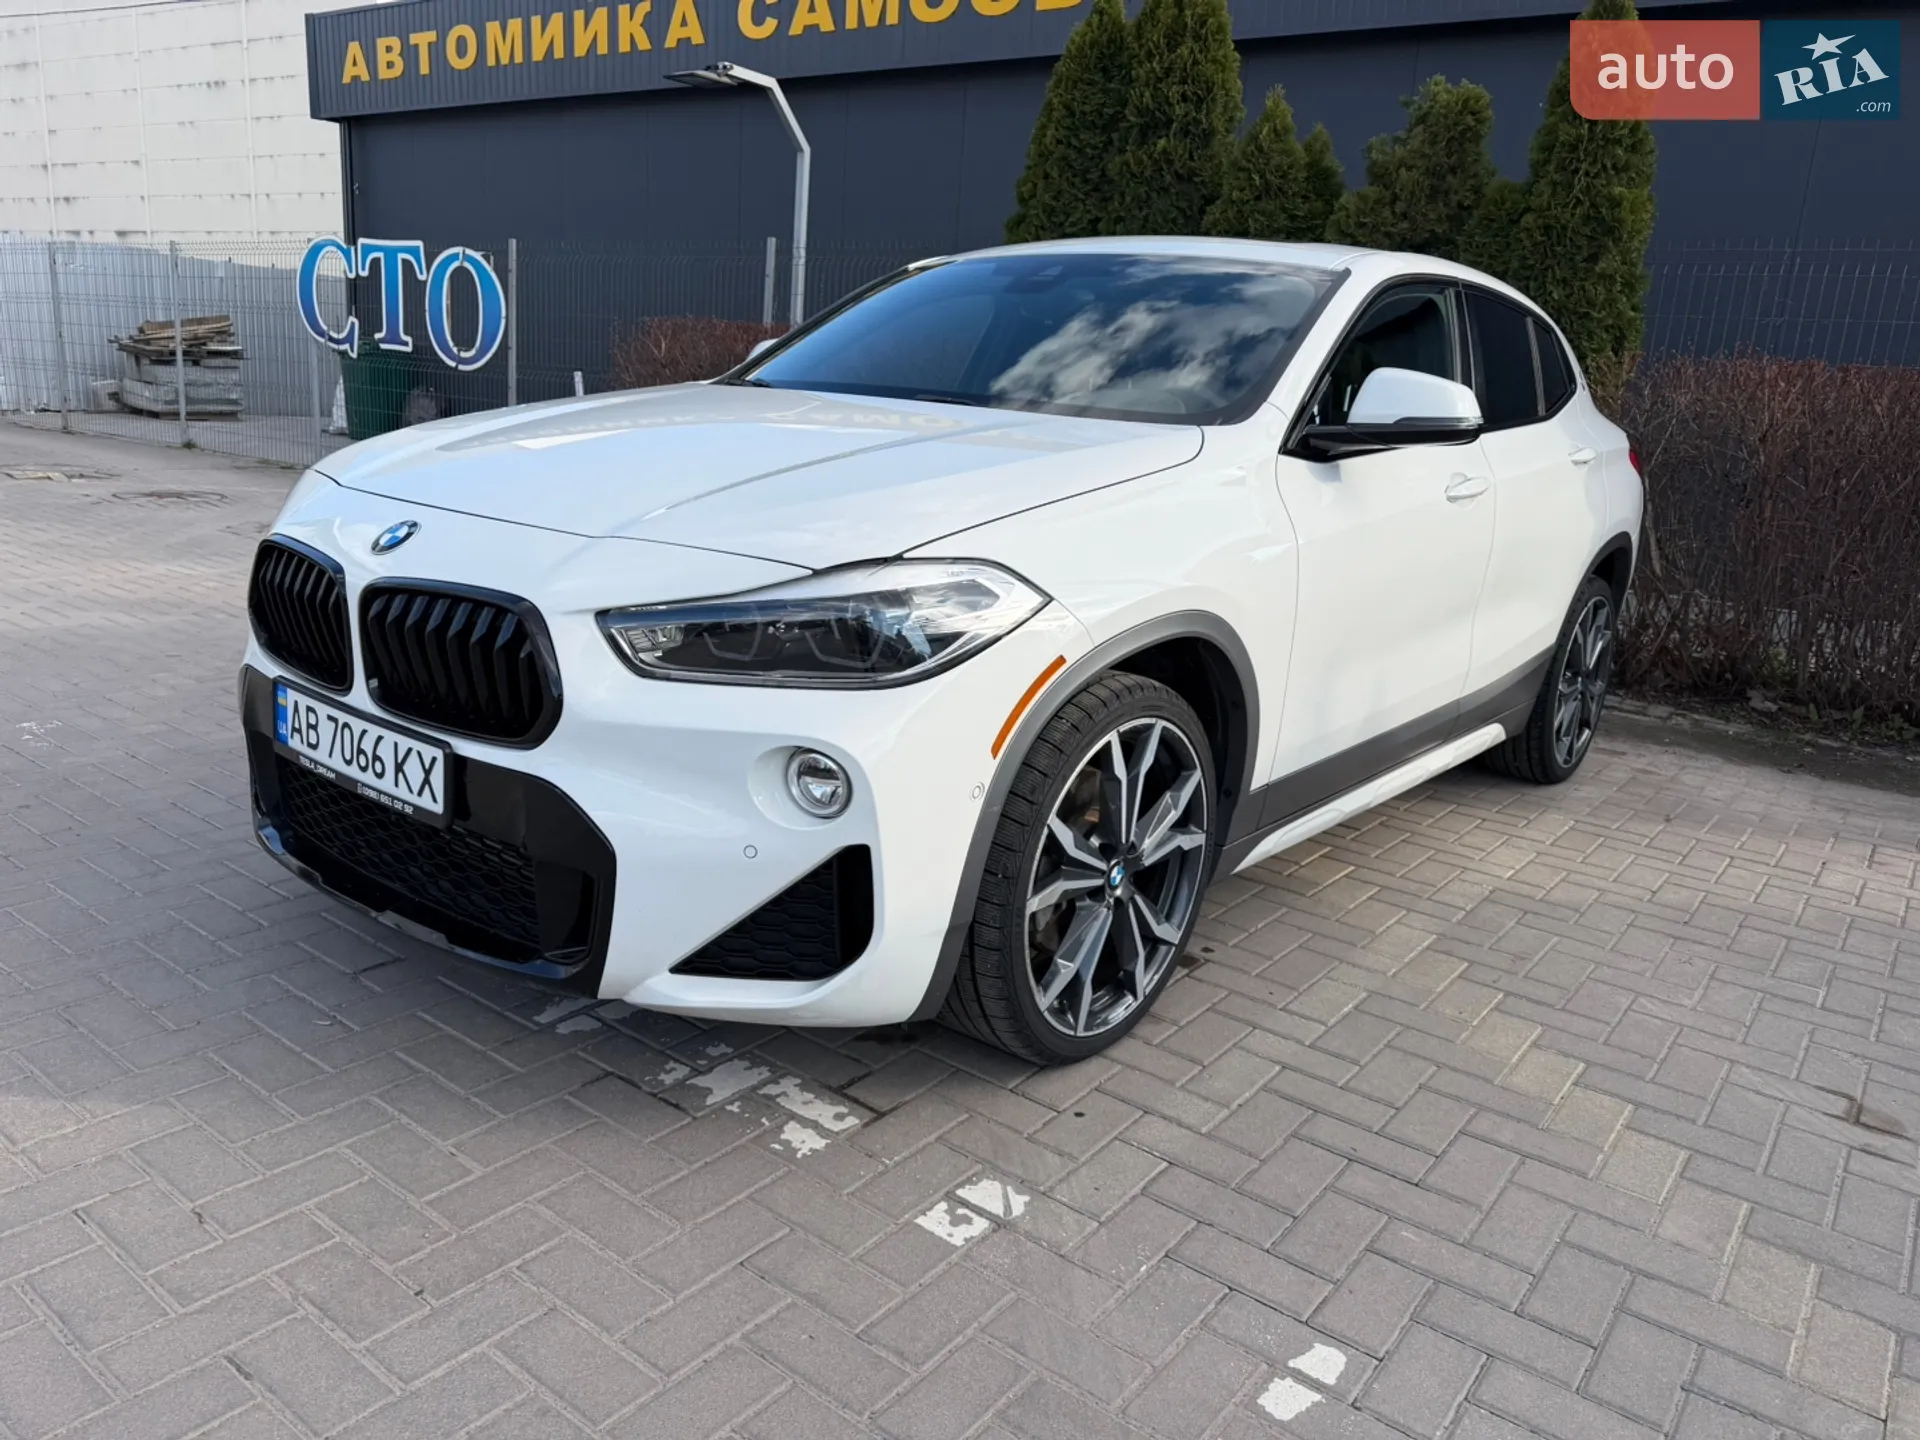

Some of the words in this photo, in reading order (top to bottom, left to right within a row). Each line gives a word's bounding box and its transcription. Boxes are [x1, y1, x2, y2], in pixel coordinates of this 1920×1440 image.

[297, 235, 506, 371] СТО
[290, 700, 320, 750] AB
[326, 713, 386, 780] 7066
[393, 741, 439, 804] KX
